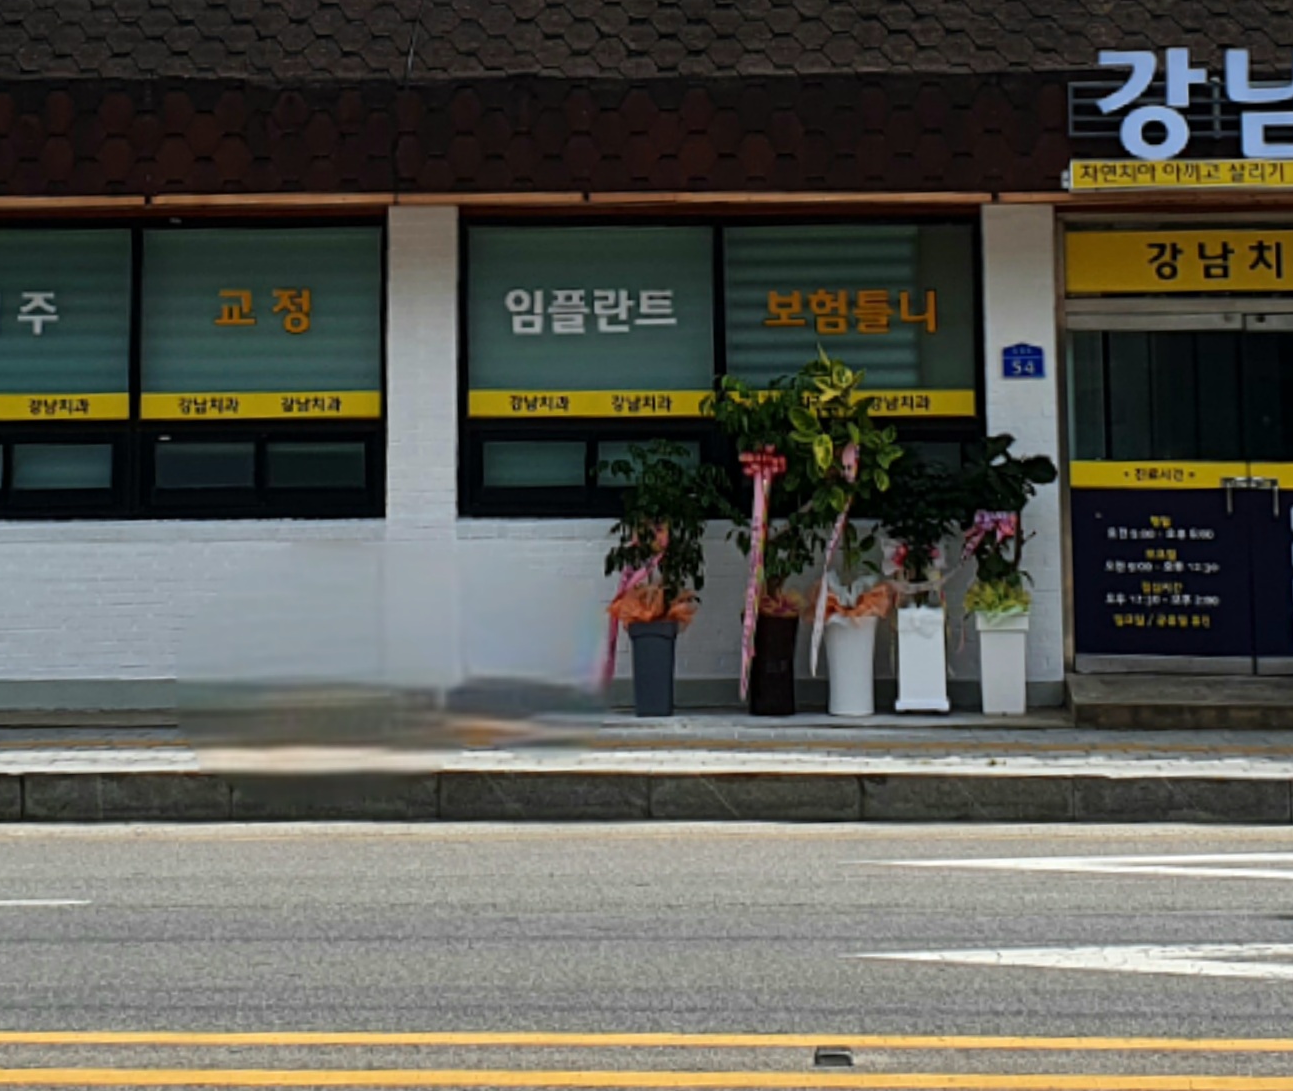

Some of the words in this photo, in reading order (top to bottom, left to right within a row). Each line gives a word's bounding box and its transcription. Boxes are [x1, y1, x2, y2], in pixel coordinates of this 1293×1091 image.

[1079, 163, 1156, 183] 자연치아
[1161, 162, 1222, 183] 아끼고
[1227, 162, 1285, 183] 살리기
[213, 288, 313, 334] 교정
[505, 288, 677, 335] 임플란트
[763, 289, 937, 334] 보험틀니
[28, 397, 89, 415] 강남치과
[177, 396, 239, 415] 강남치과
[280, 395, 342, 413] 강남치과
[509, 394, 570, 412] 강남치과
[611, 393, 672, 412] 강남치과
